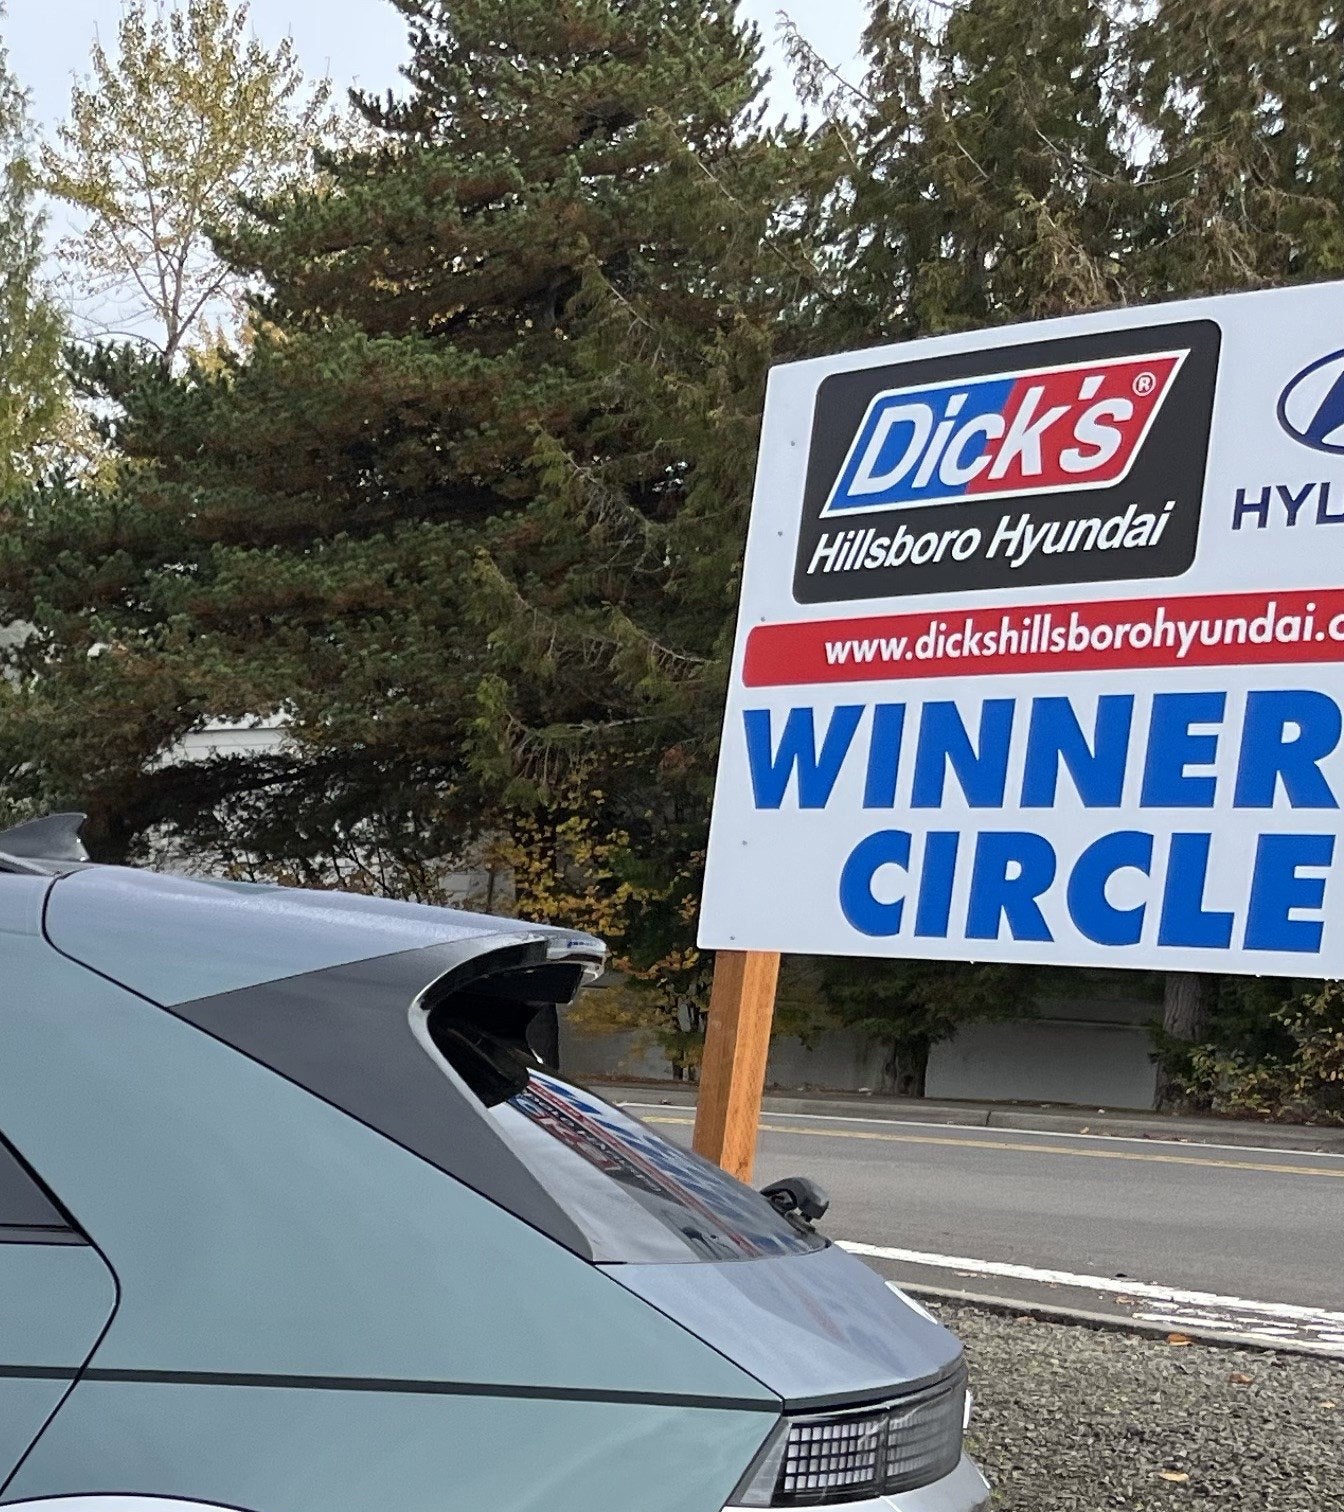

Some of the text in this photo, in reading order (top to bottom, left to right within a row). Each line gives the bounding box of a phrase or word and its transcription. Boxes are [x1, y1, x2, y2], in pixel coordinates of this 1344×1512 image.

[807, 501, 1176, 575] Hillsboro Hyundai
[742, 689, 1342, 810] WINNER
[839, 828, 1336, 954] CIRCLE
